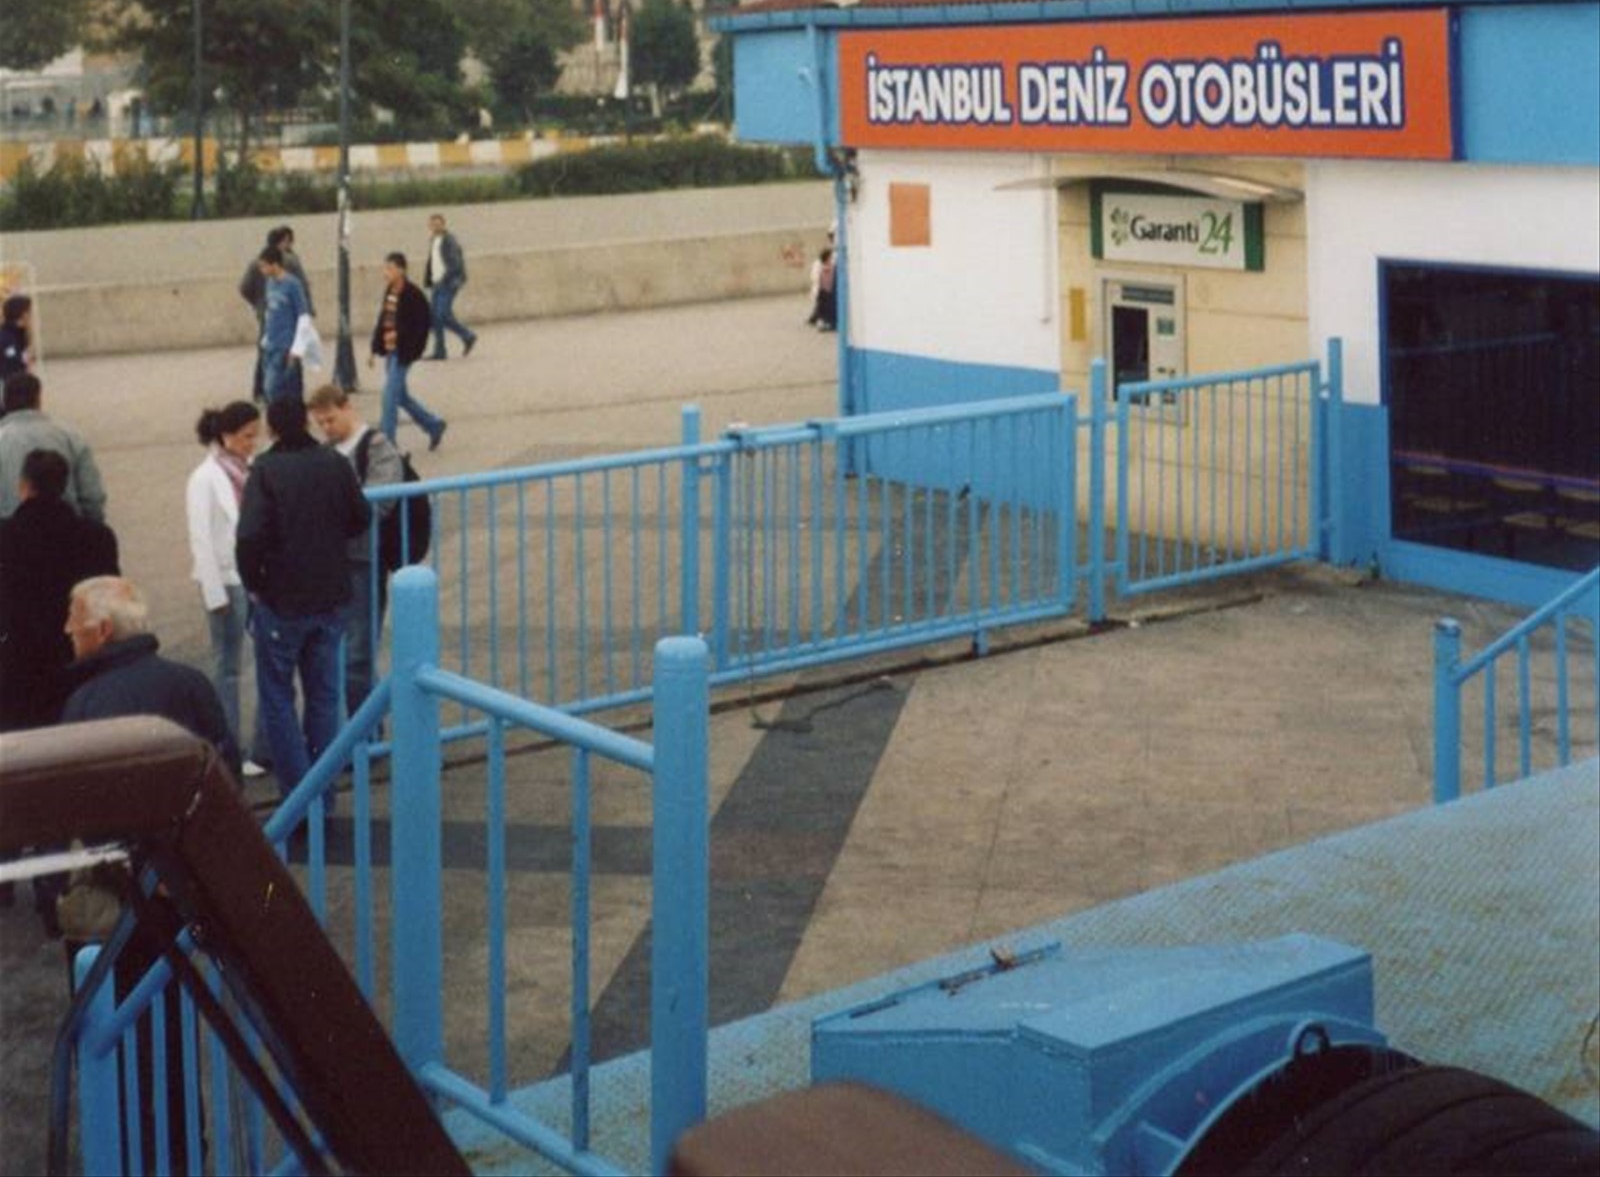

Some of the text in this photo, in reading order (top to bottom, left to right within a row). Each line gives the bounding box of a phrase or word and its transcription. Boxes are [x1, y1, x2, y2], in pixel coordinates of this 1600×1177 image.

[866, 38, 1404, 127] İSTANBUL DENİZ OTOBÜSLERİ
